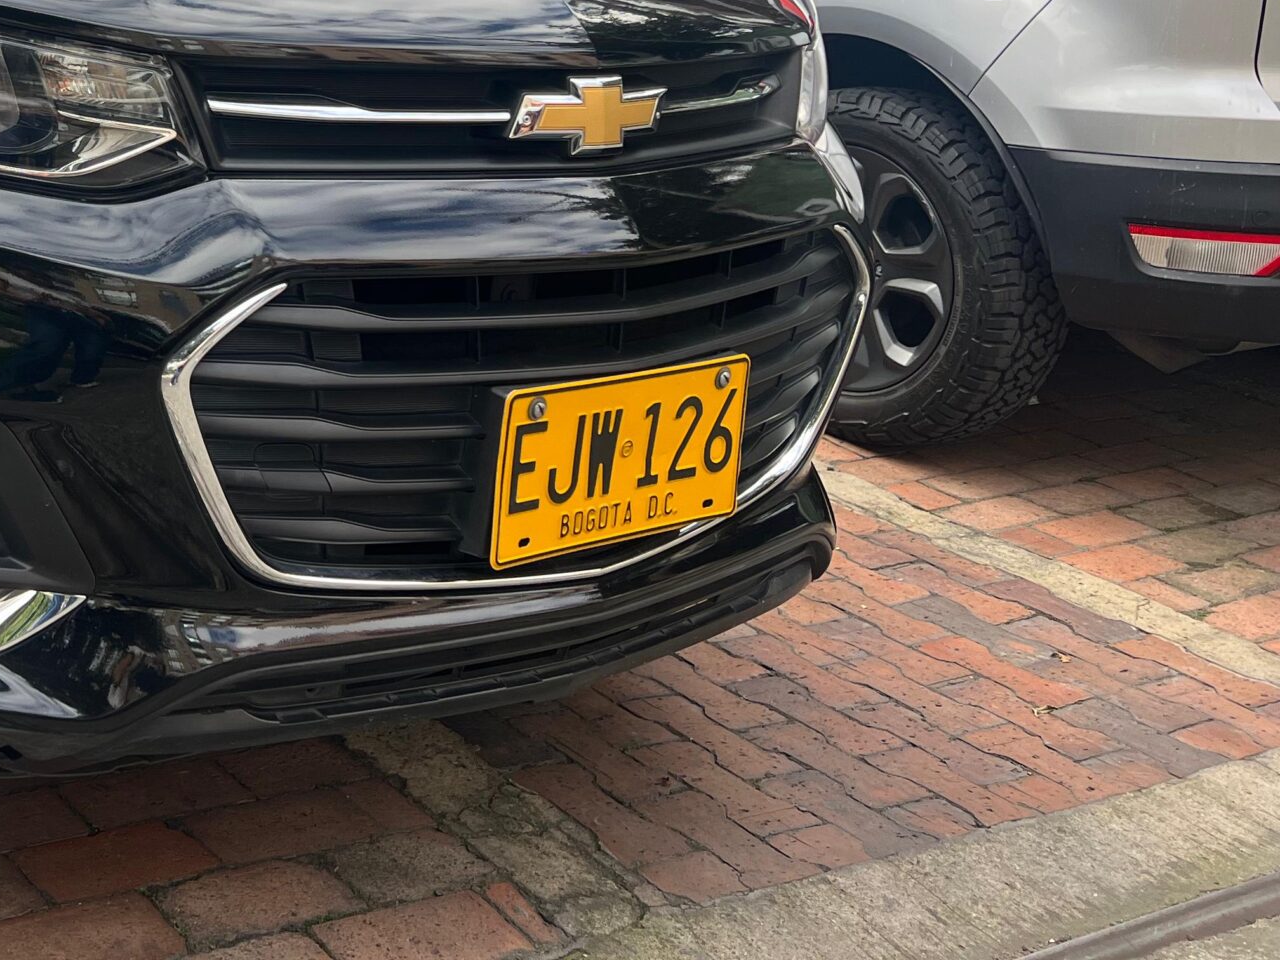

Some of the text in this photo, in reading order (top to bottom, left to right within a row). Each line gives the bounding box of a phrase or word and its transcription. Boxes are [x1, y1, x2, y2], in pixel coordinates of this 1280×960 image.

[508, 388, 738, 516] EJW 126
[559, 501, 633, 538] BOGOTA
